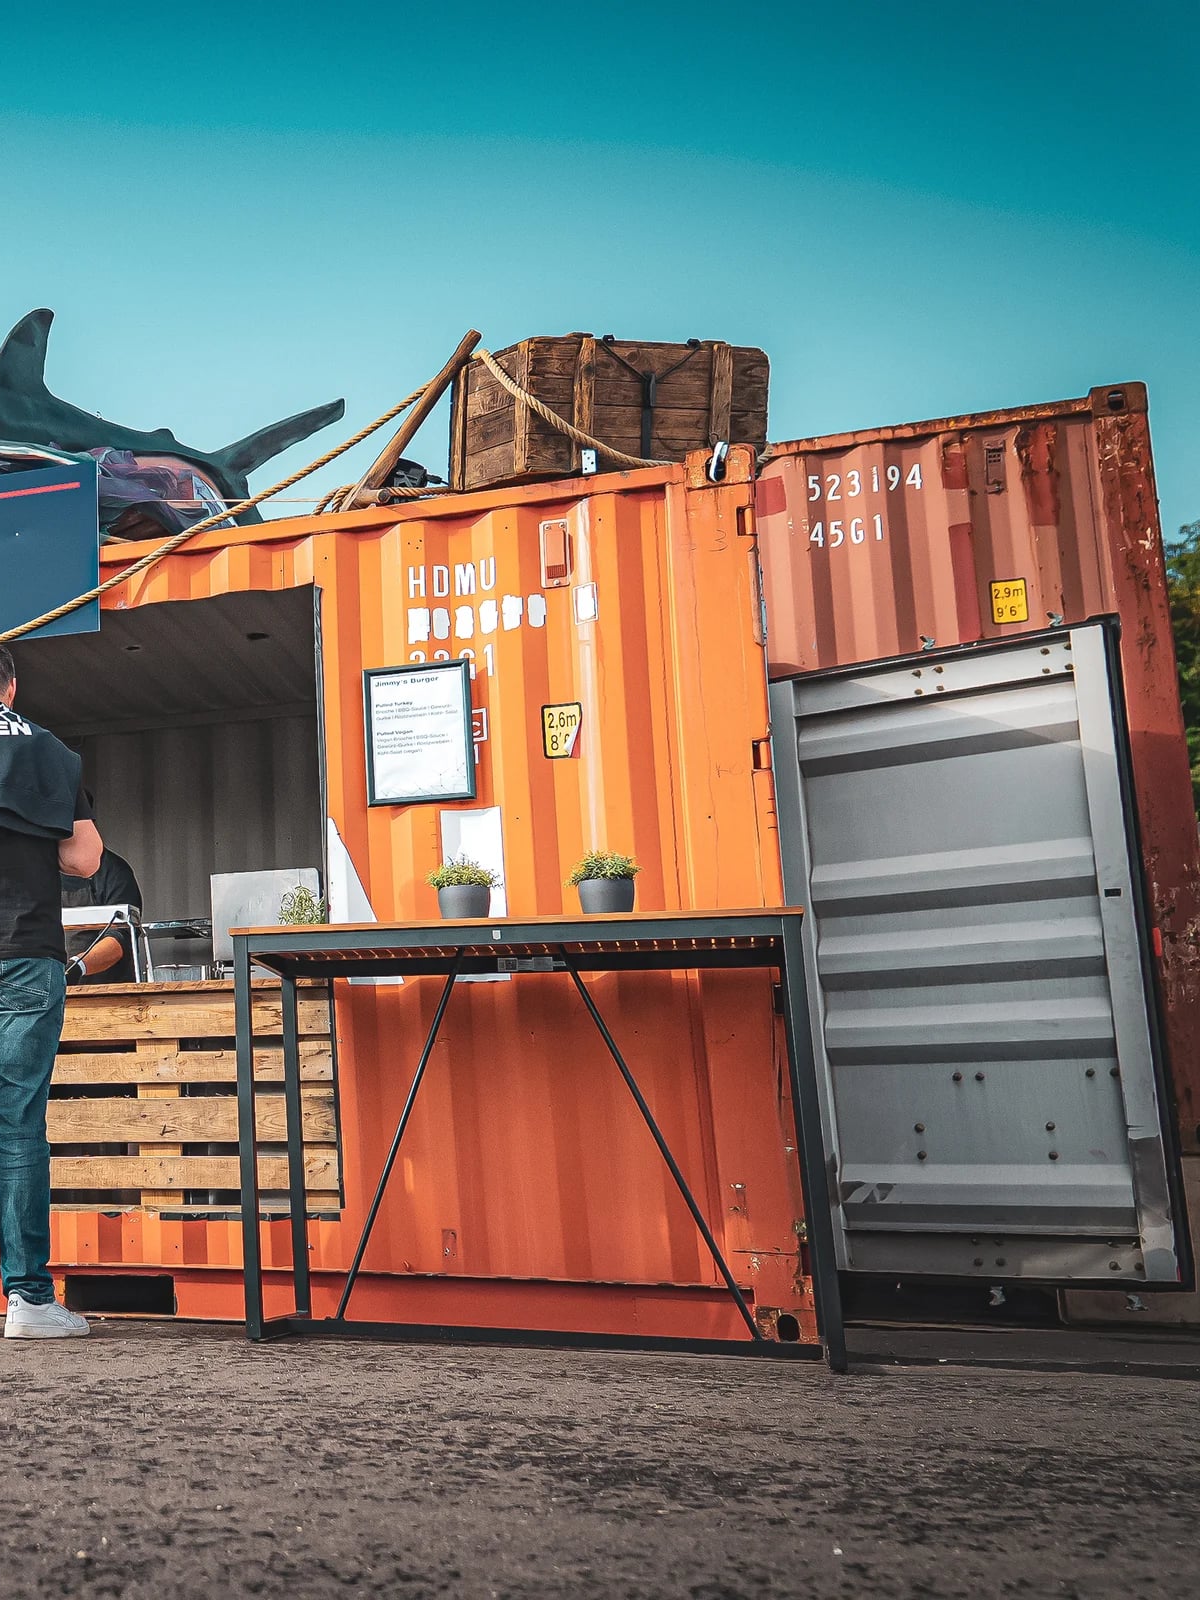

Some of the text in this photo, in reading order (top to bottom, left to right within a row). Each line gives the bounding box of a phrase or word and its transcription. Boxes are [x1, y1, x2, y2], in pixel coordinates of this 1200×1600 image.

[808, 464, 922, 501] 523194
[810, 514, 883, 548] 45G1
[407, 556, 496, 599] HDMU
[375, 678, 408, 688] Jimmy's
[548, 711, 577, 730] 2,6m
